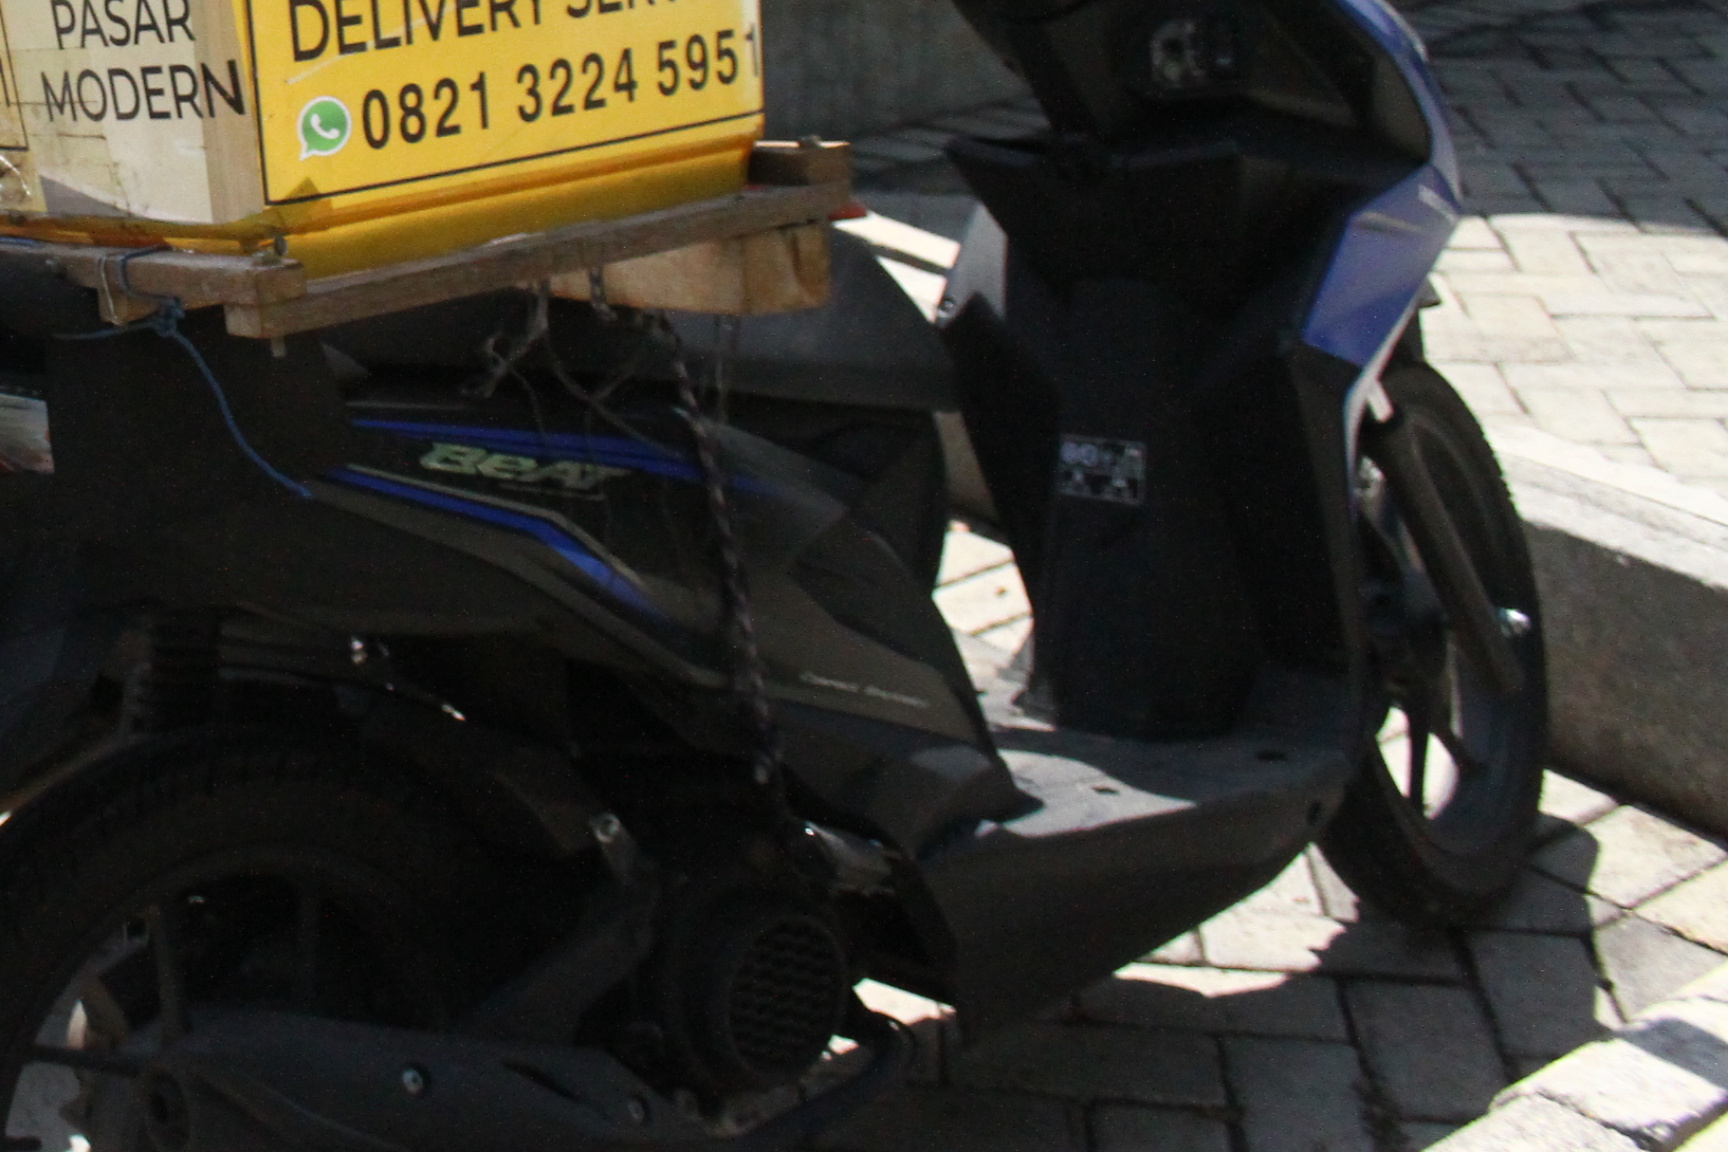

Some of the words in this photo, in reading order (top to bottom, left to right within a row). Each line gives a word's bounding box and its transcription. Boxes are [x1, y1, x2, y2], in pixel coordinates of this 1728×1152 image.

[40, 58, 246, 123] MODERN
[361, 70, 490, 150] 0821
[516, 47, 639, 123] 3224
[657, 21, 760, 97] 5951
